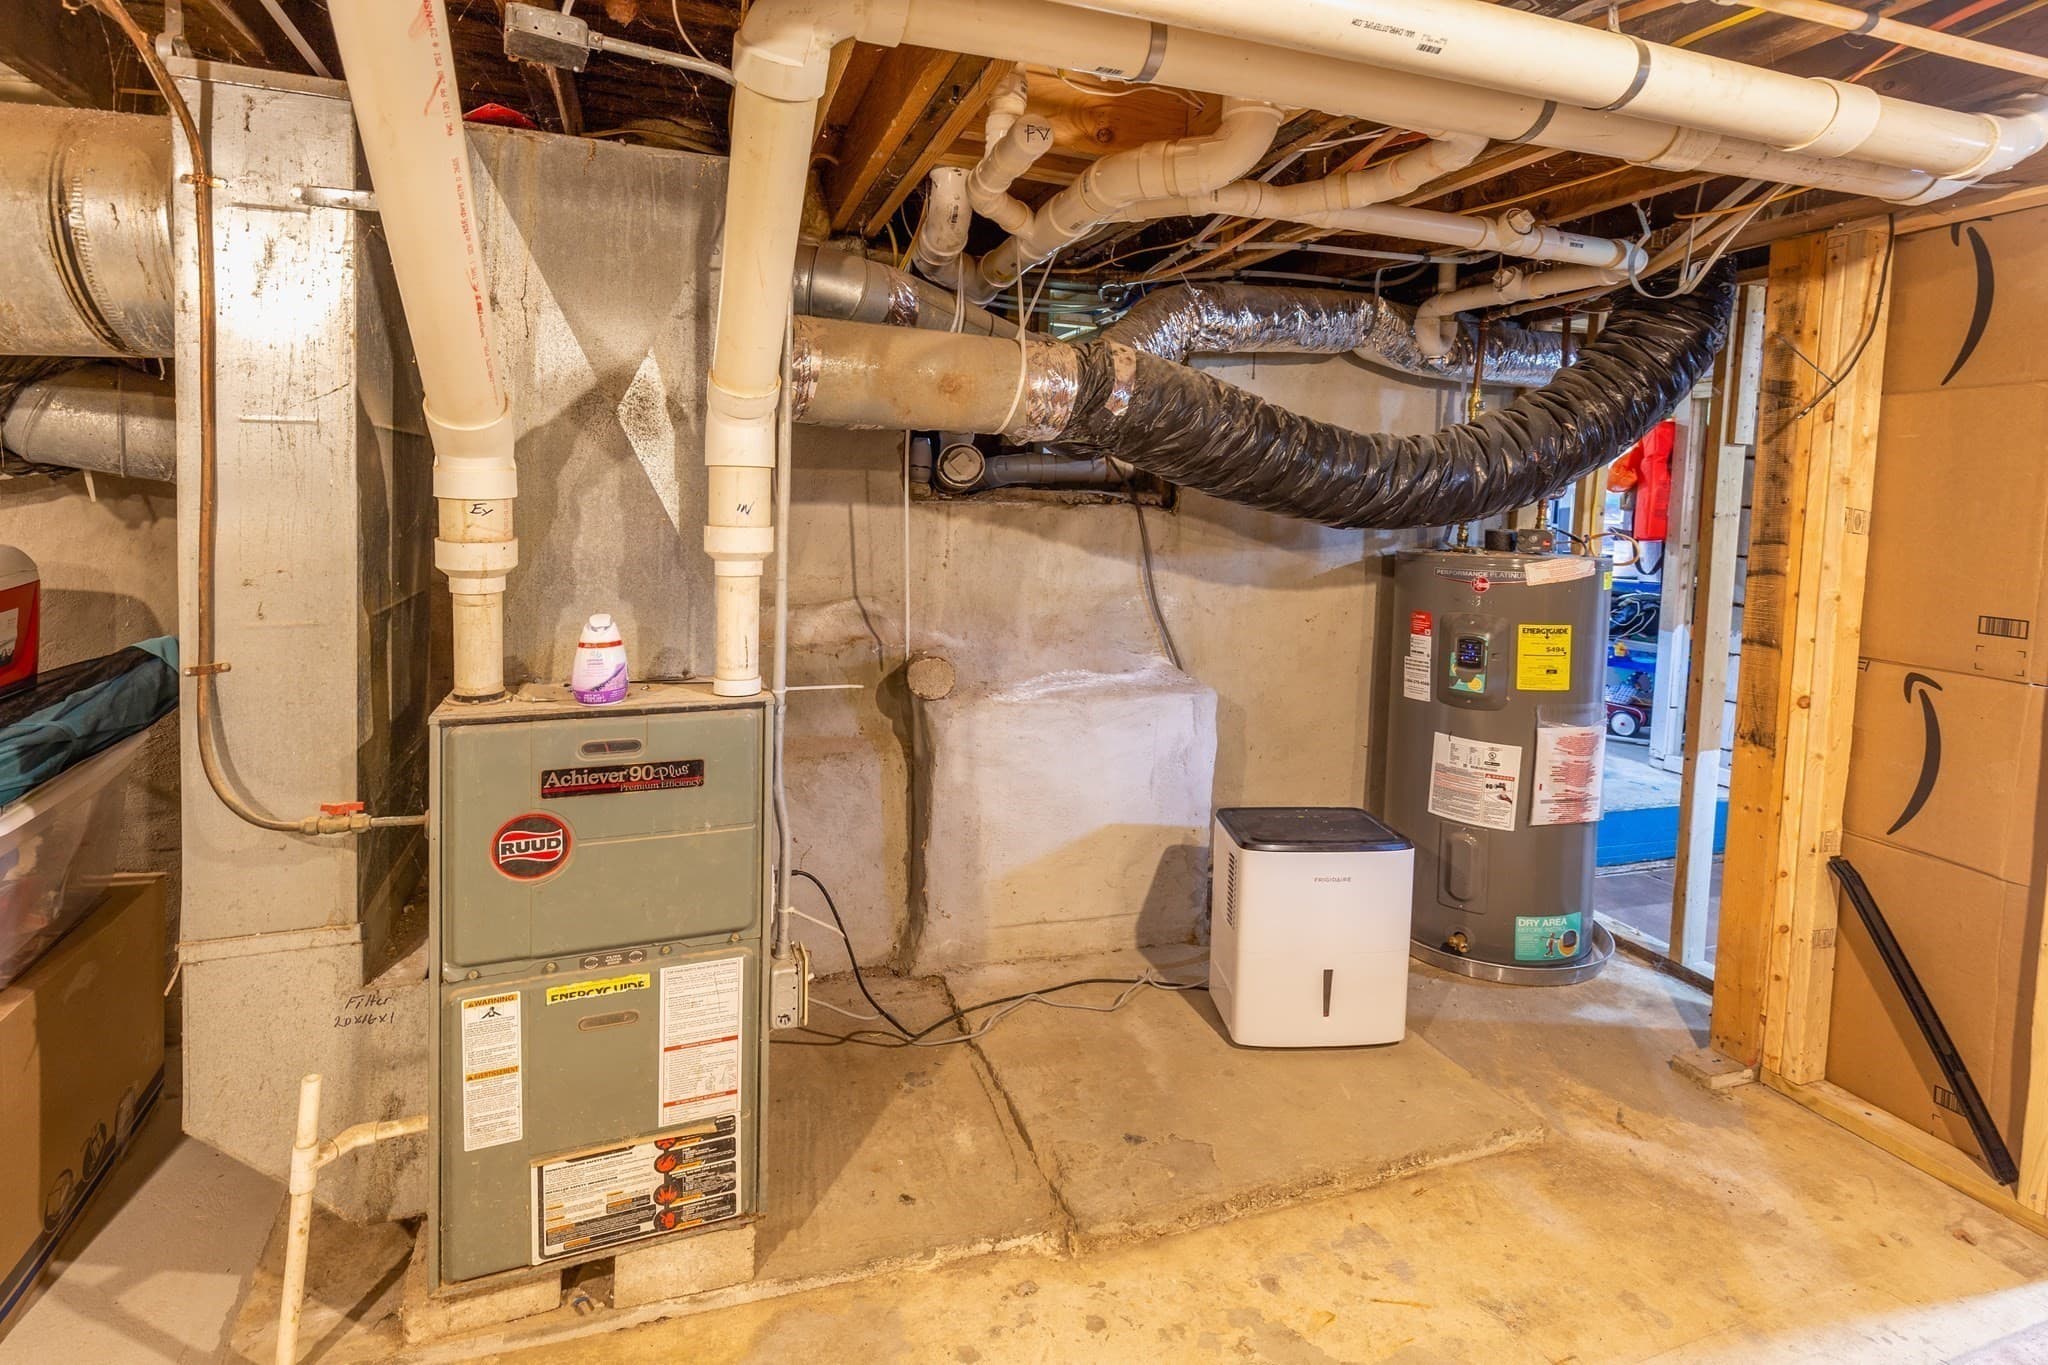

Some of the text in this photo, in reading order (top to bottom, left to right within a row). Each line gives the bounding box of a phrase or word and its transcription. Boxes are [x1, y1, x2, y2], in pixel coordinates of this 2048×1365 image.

[1436, 569, 1489, 578] PERFORMANCE
[544, 768, 625, 789] Achiever
[629, 765, 654, 782] 90
[620, 778, 701, 792] Premium Efficiency
[501, 837, 562, 855] RUUD
[1518, 917, 1568, 927] DRY AREA
[345, 993, 393, 1010] Filter
[473, 994, 515, 1007] WARNING
